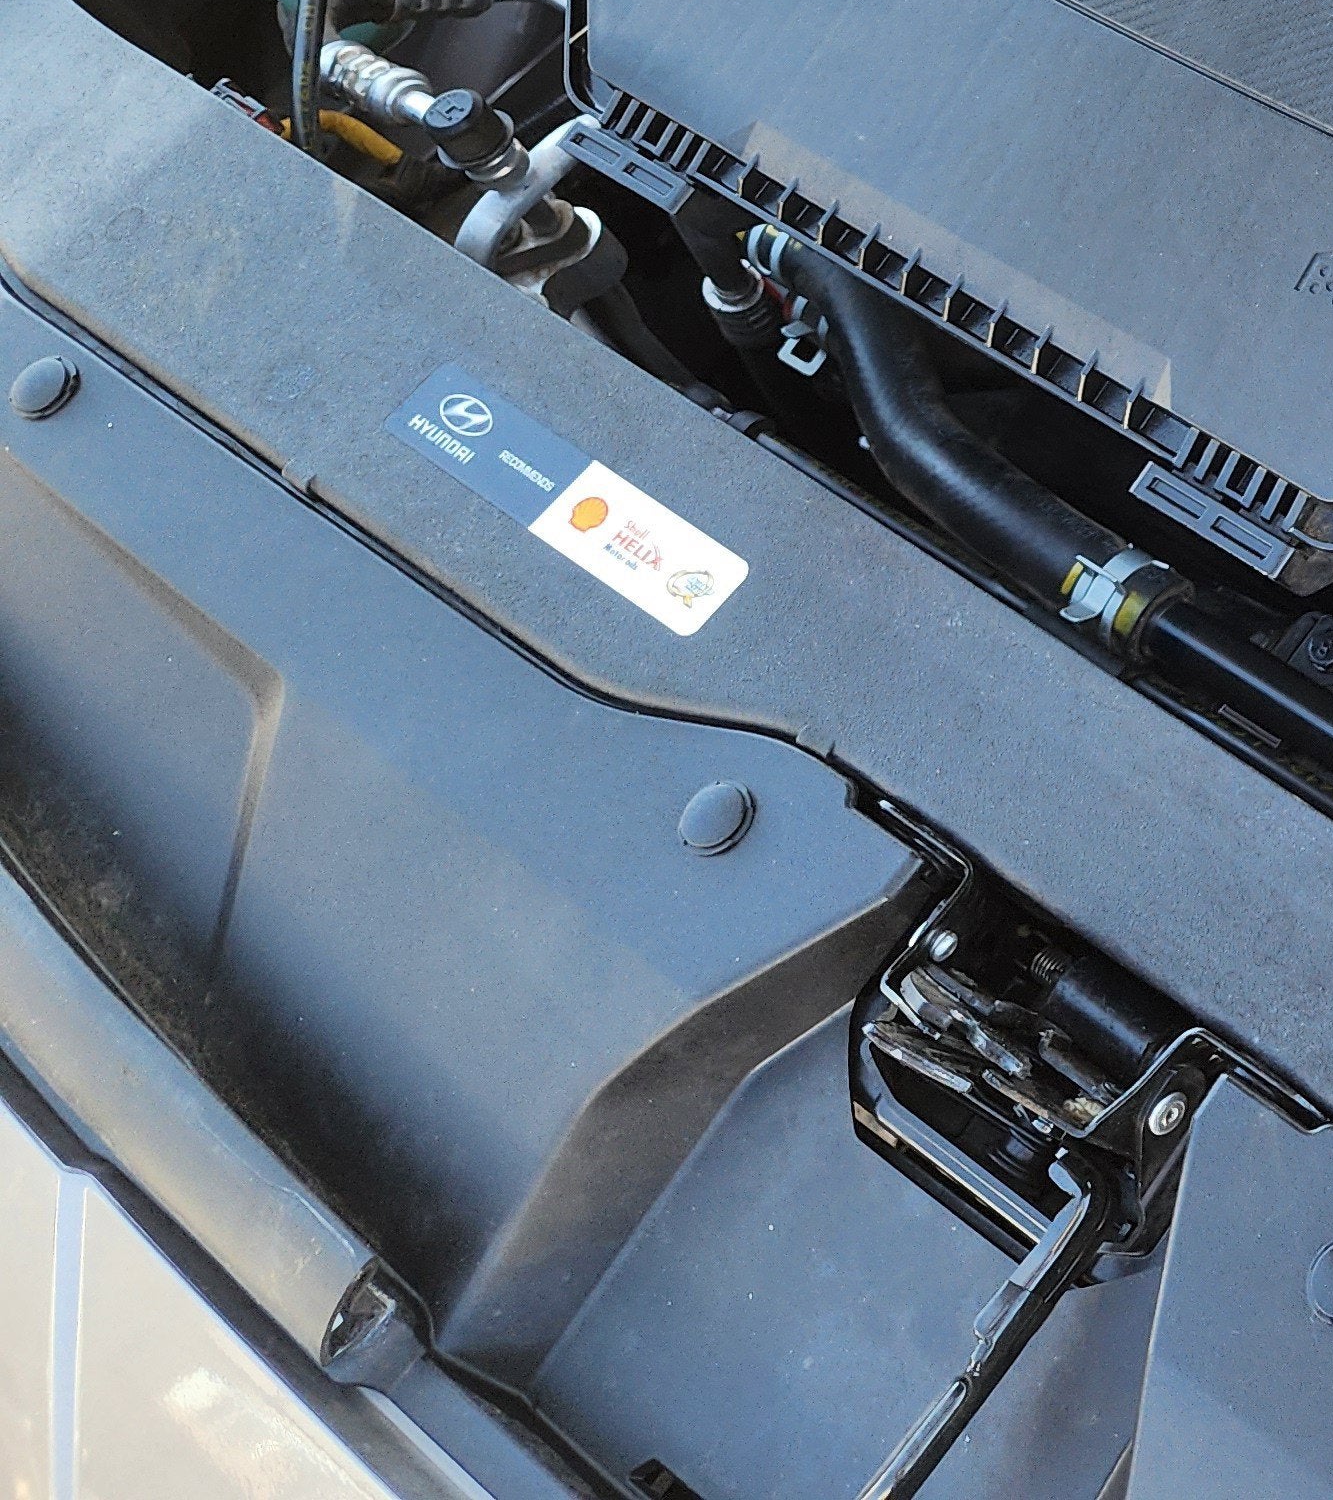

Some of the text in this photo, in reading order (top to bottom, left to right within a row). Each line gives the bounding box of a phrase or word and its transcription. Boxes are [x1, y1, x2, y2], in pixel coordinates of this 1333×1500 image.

[407, 414, 475, 465] HYUNDAI
[496, 448, 556, 493] RECOMMENDS
[610, 528, 666, 572] HELIX
[622, 518, 649, 542] Shell
